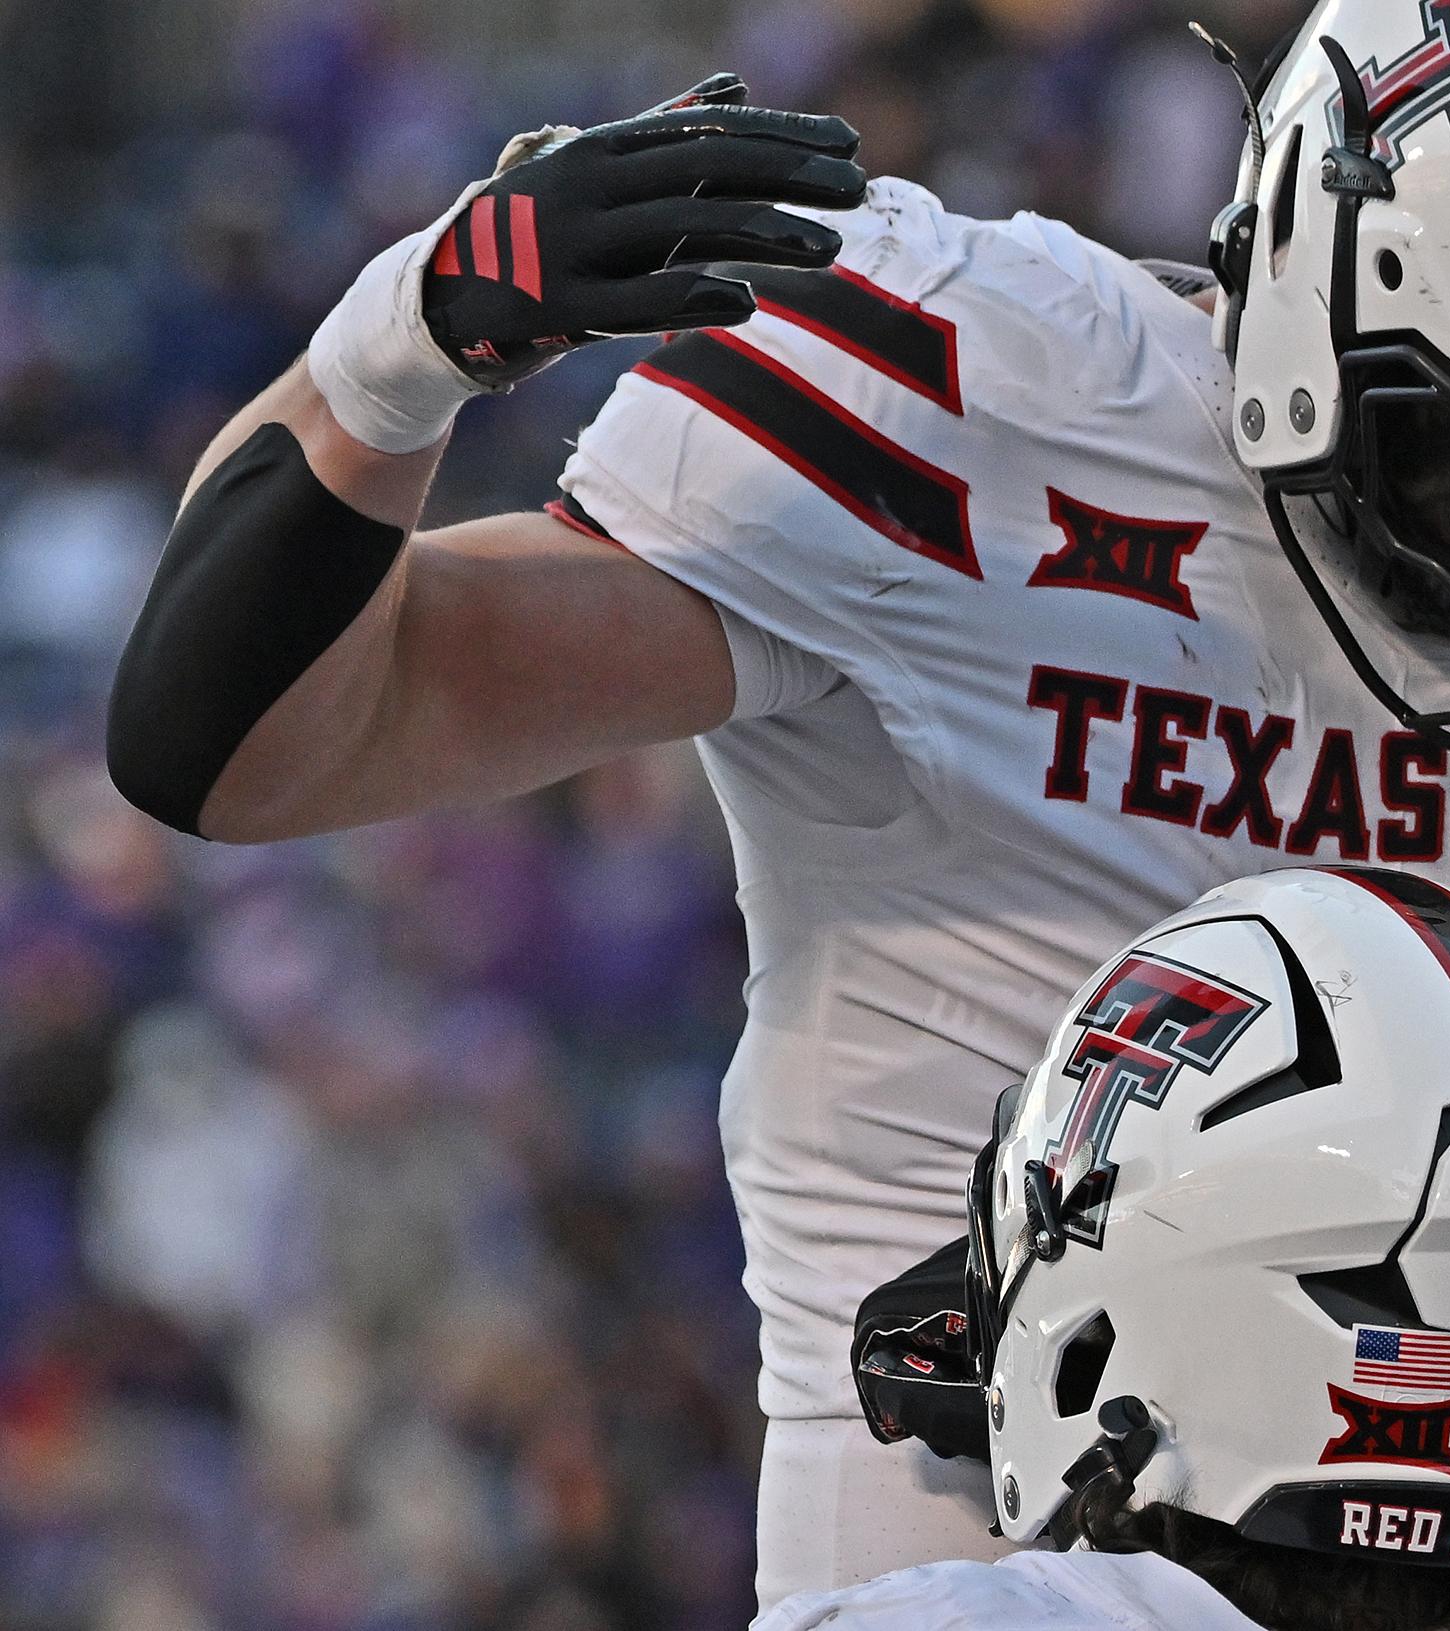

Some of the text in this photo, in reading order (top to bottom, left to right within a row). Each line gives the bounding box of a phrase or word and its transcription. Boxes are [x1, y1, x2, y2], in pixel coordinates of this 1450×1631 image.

[1031, 490, 1206, 617] XII
[1027, 664, 1448, 863] TEXAS
[1341, 1500, 1442, 1553] RED
